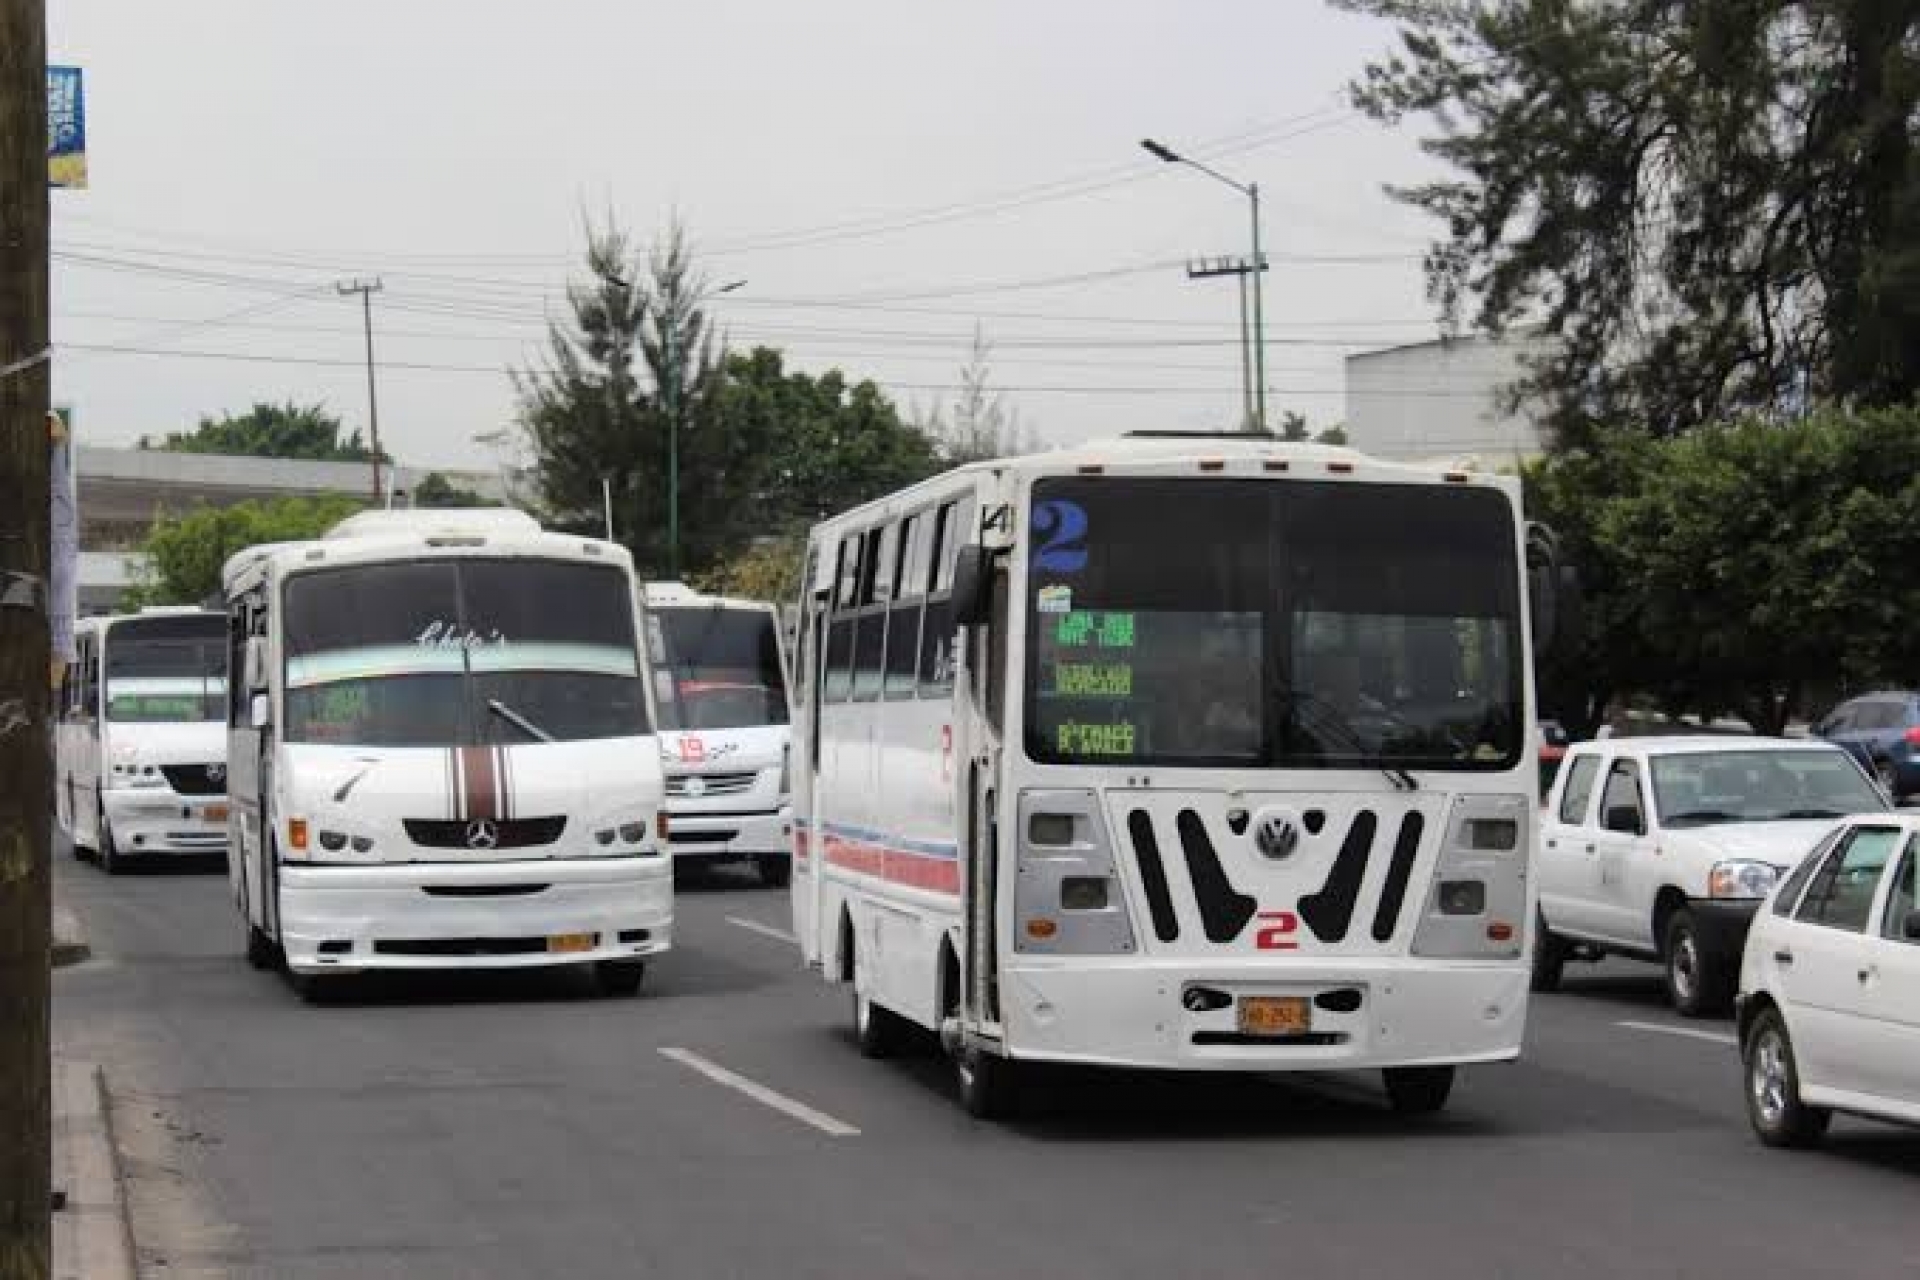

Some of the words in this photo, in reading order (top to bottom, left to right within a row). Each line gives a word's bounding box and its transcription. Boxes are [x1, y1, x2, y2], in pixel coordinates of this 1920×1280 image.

[1033, 500, 1087, 571] 2
[679, 736, 704, 762] 19
[1256, 911, 1299, 949] 2
